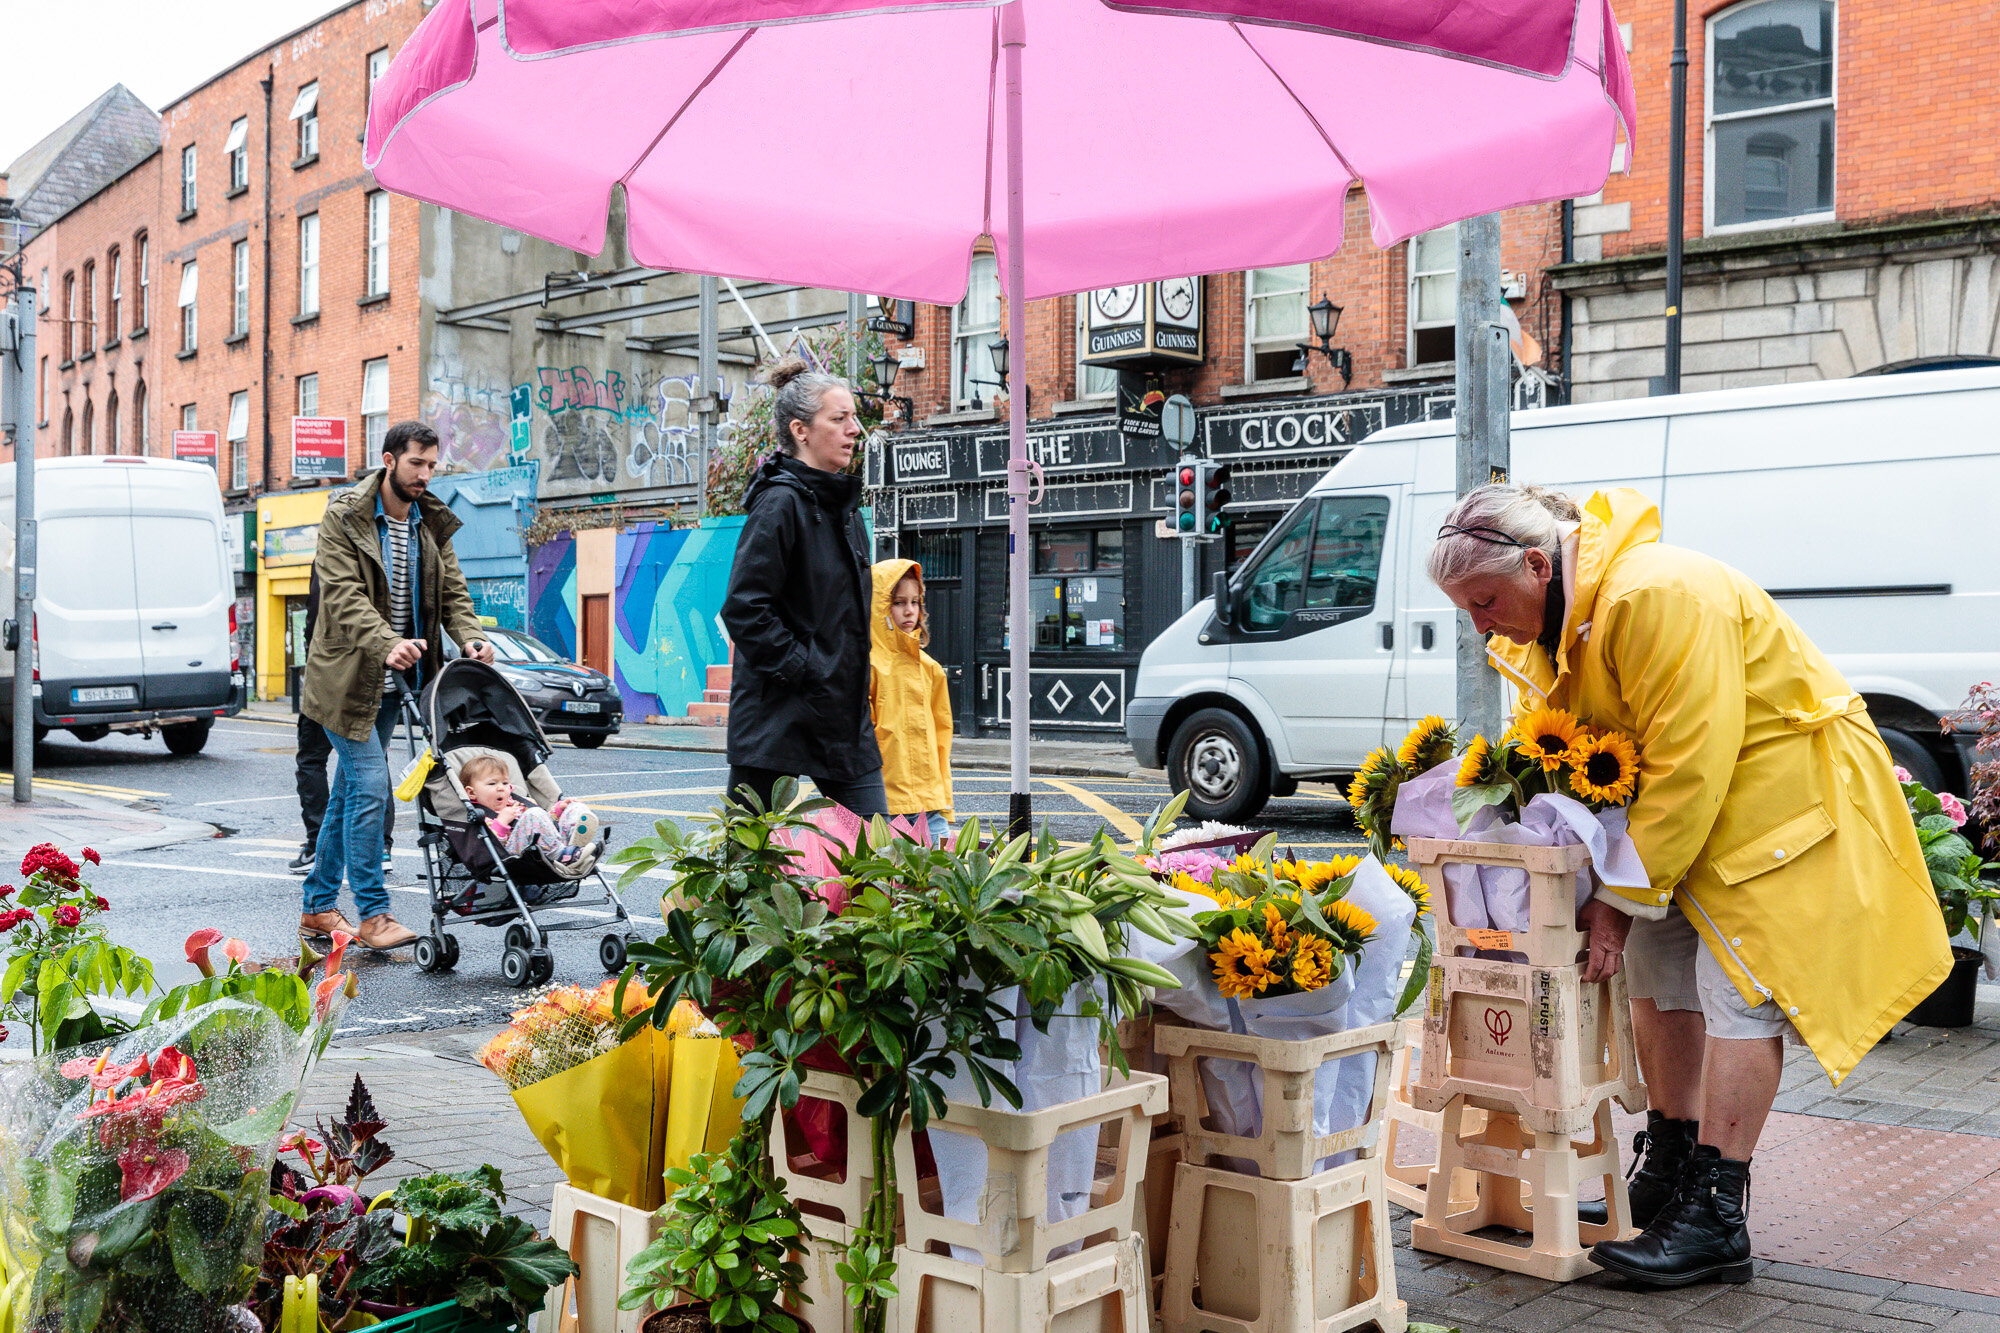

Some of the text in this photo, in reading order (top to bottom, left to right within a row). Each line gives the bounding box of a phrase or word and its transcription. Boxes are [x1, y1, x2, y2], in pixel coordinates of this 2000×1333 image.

[876, 320, 906, 333] GUINNESS
[1091, 328, 1142, 352] GUINNESS
[1156, 331, 1197, 348] GUINNESS
[1123, 425, 1160, 436] BEER GARDEN
[1240, 413, 1346, 450] CLOCK
[1025, 436, 1072, 465] THE
[296, 457, 327, 465] TO LET
[898, 451, 942, 472] LOUNGE
[1296, 612, 1342, 621] TRANSIT
